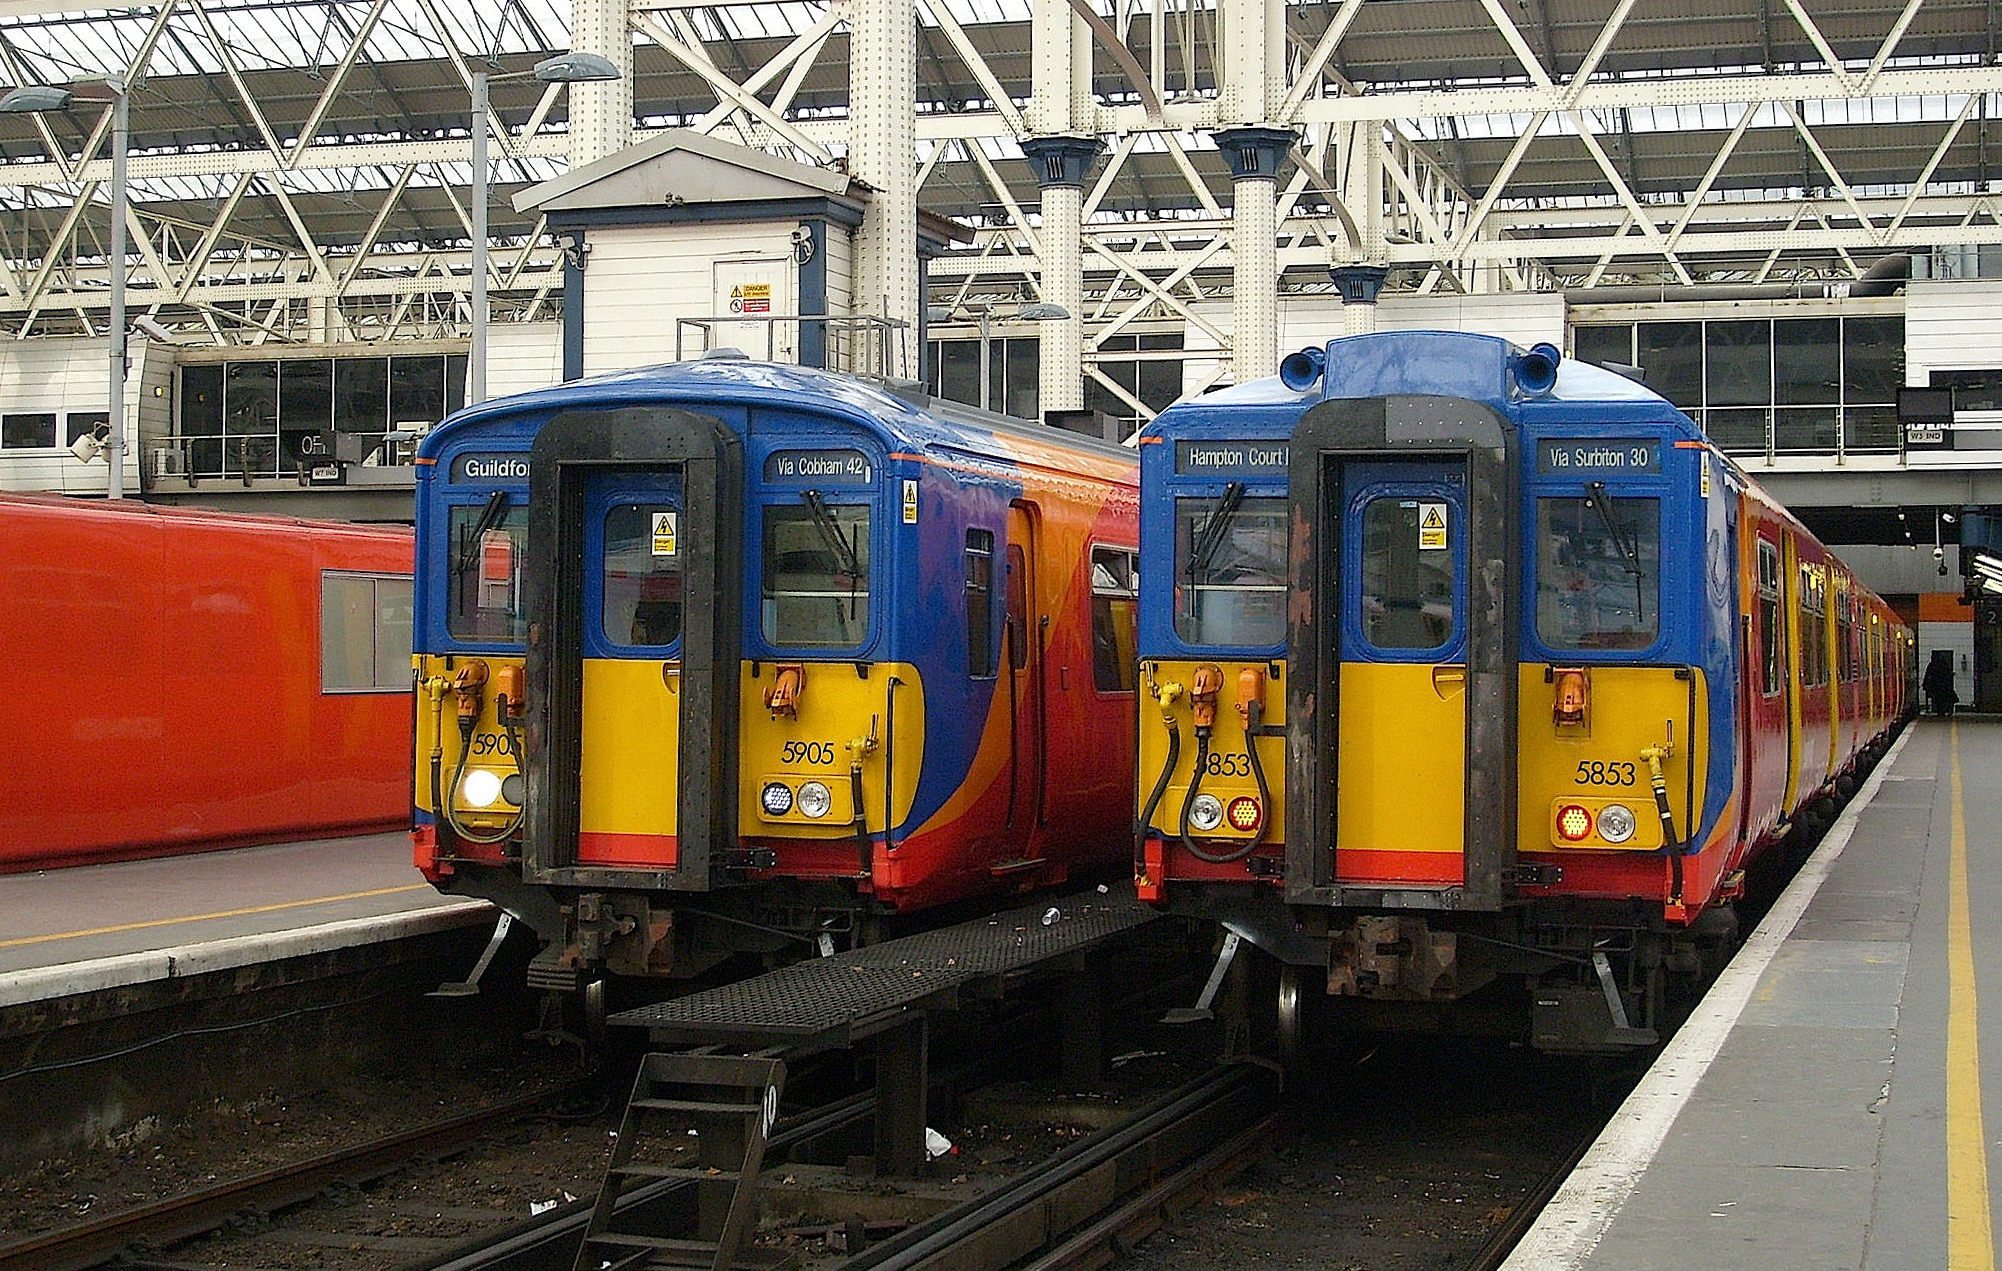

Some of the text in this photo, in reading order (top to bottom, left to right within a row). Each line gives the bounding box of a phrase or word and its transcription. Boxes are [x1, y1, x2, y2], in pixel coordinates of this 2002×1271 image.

[777, 456, 863, 475] Via Cobham 42
[1190, 447, 1283, 469] Hampton Court
[1550, 447, 1648, 467] Via Surbiton 30
[1987, 611, 1997, 624] 2
[781, 741, 835, 765] 5905
[1574, 760, 1636, 786] 5853
